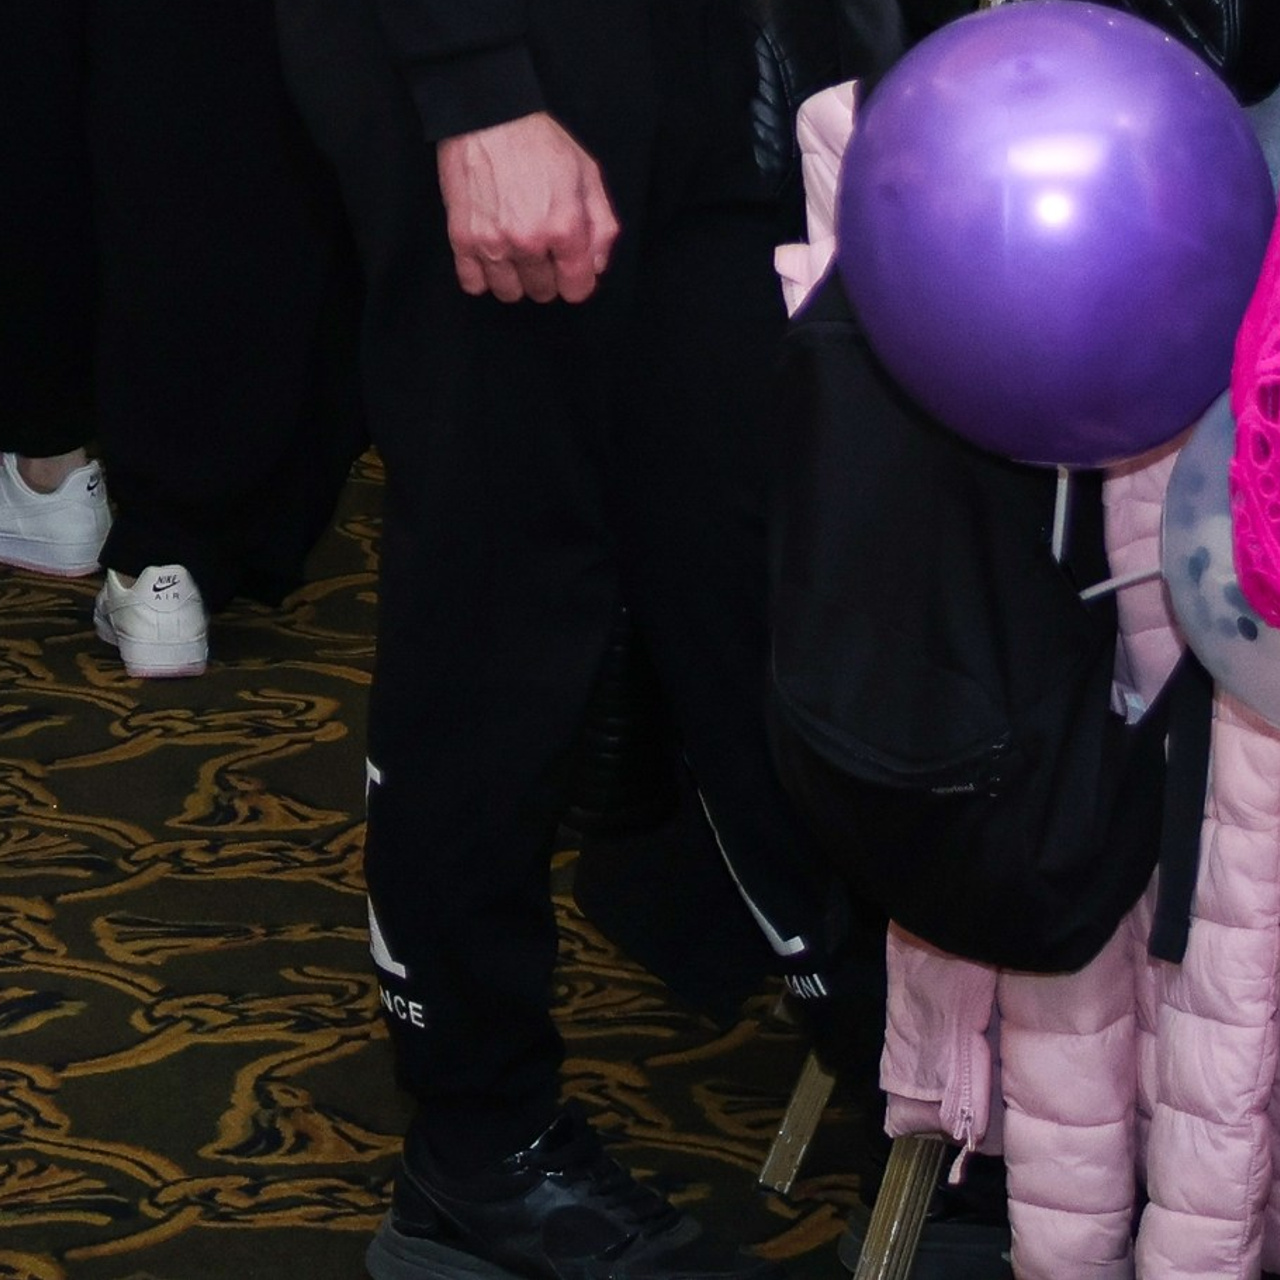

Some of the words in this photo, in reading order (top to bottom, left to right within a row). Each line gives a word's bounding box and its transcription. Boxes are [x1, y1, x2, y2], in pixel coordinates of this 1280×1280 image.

[157, 574, 178, 584] NIKE
[154, 592, 180, 600] AIR
[378, 983, 426, 1029] NCE
